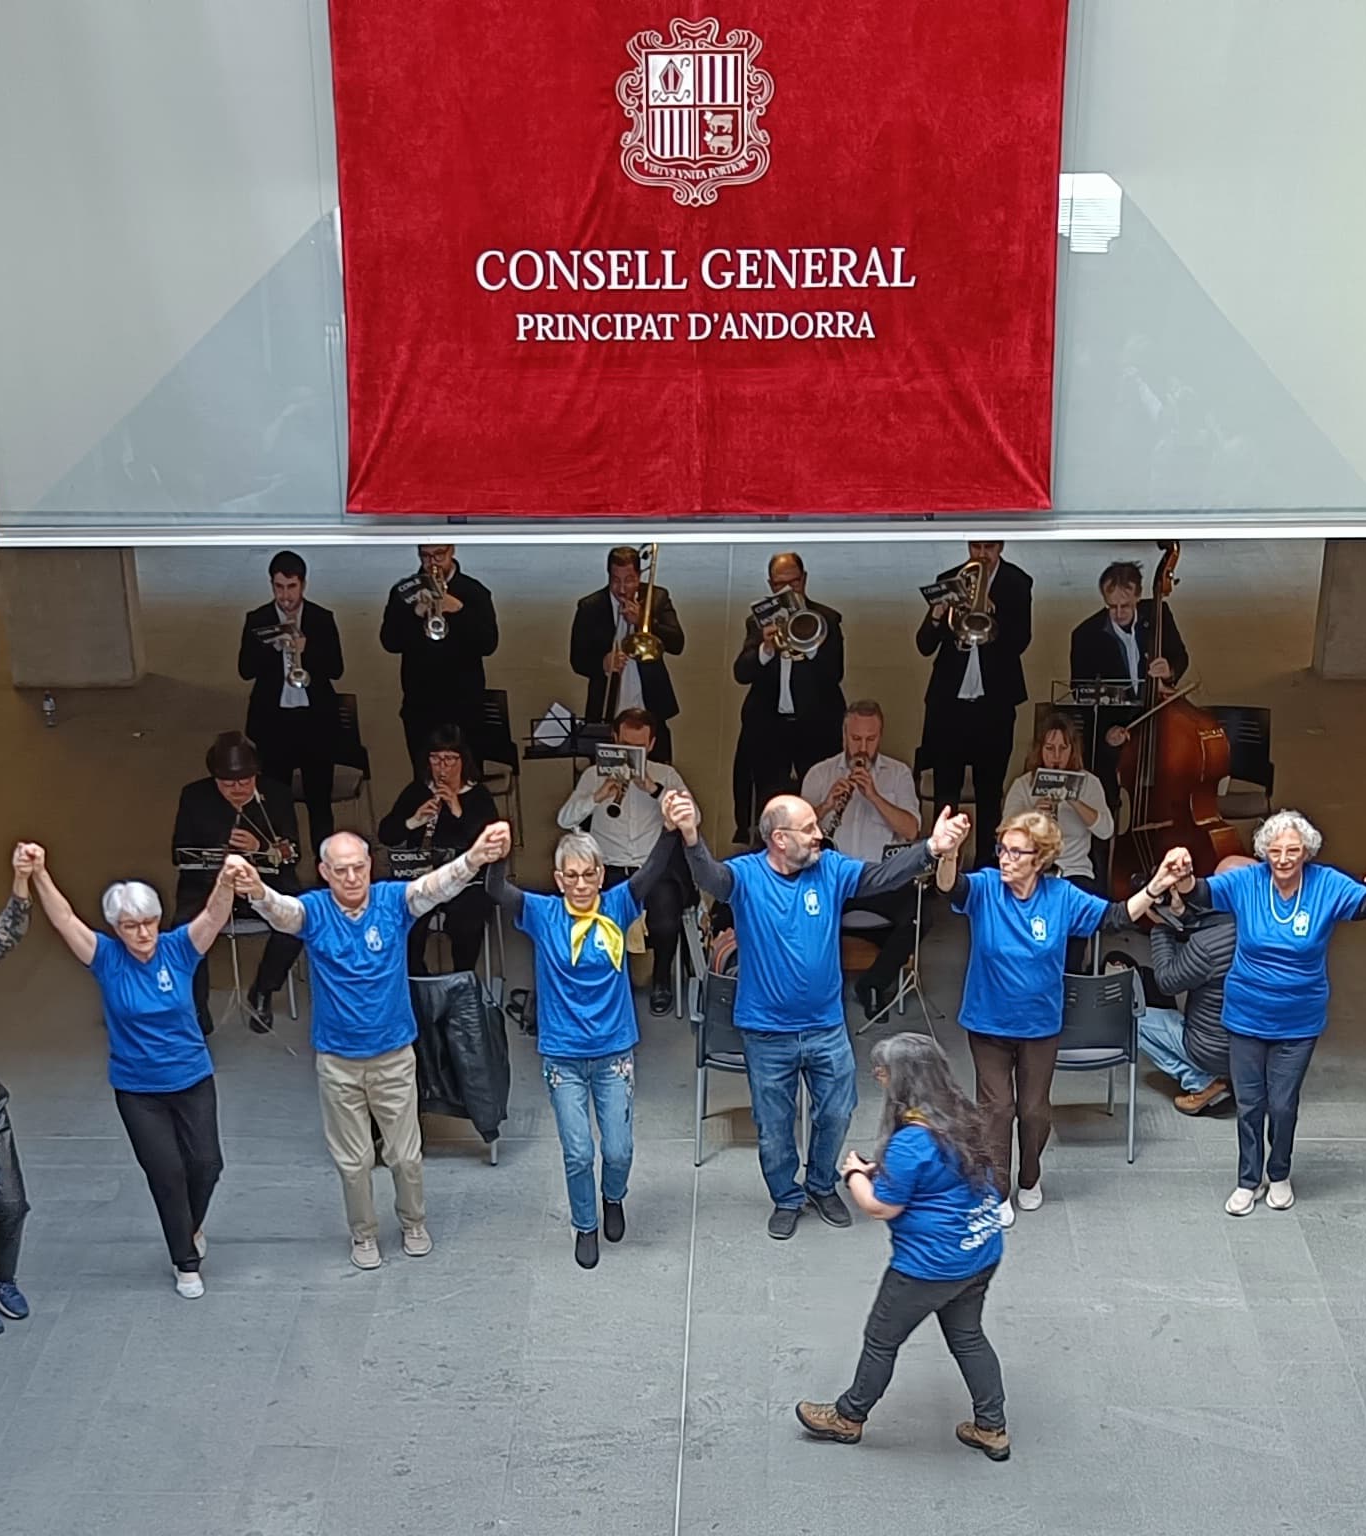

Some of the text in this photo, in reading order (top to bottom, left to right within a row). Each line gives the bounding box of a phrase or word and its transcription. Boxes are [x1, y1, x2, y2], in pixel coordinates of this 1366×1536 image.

[475, 246, 916, 292] CONSELL GENERAL
[516, 311, 875, 342] PRINCIPAT D'ANDORRA
